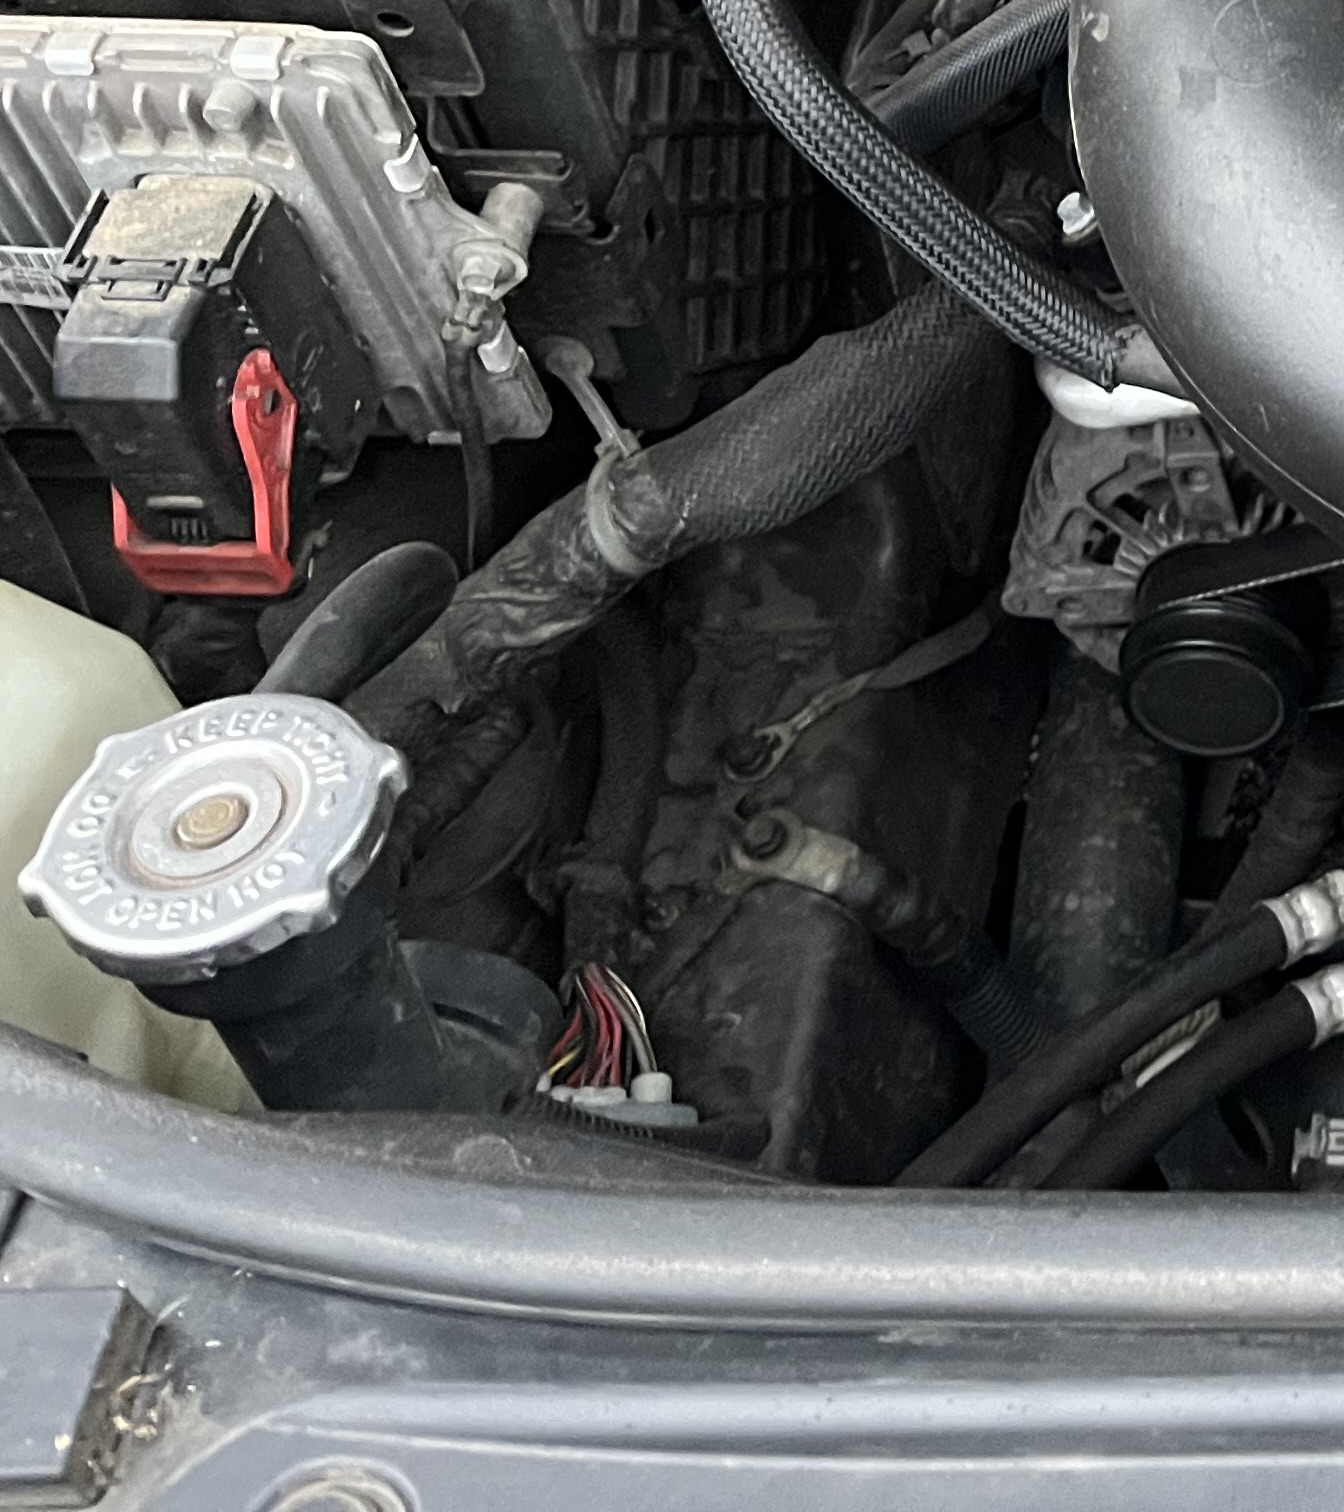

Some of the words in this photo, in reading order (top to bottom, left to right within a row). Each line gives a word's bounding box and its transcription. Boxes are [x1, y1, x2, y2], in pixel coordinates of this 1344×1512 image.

[163, 708, 284, 754] KEEP
[105, 890, 218, 931] OPEN
[226, 842, 306, 907] HOT
